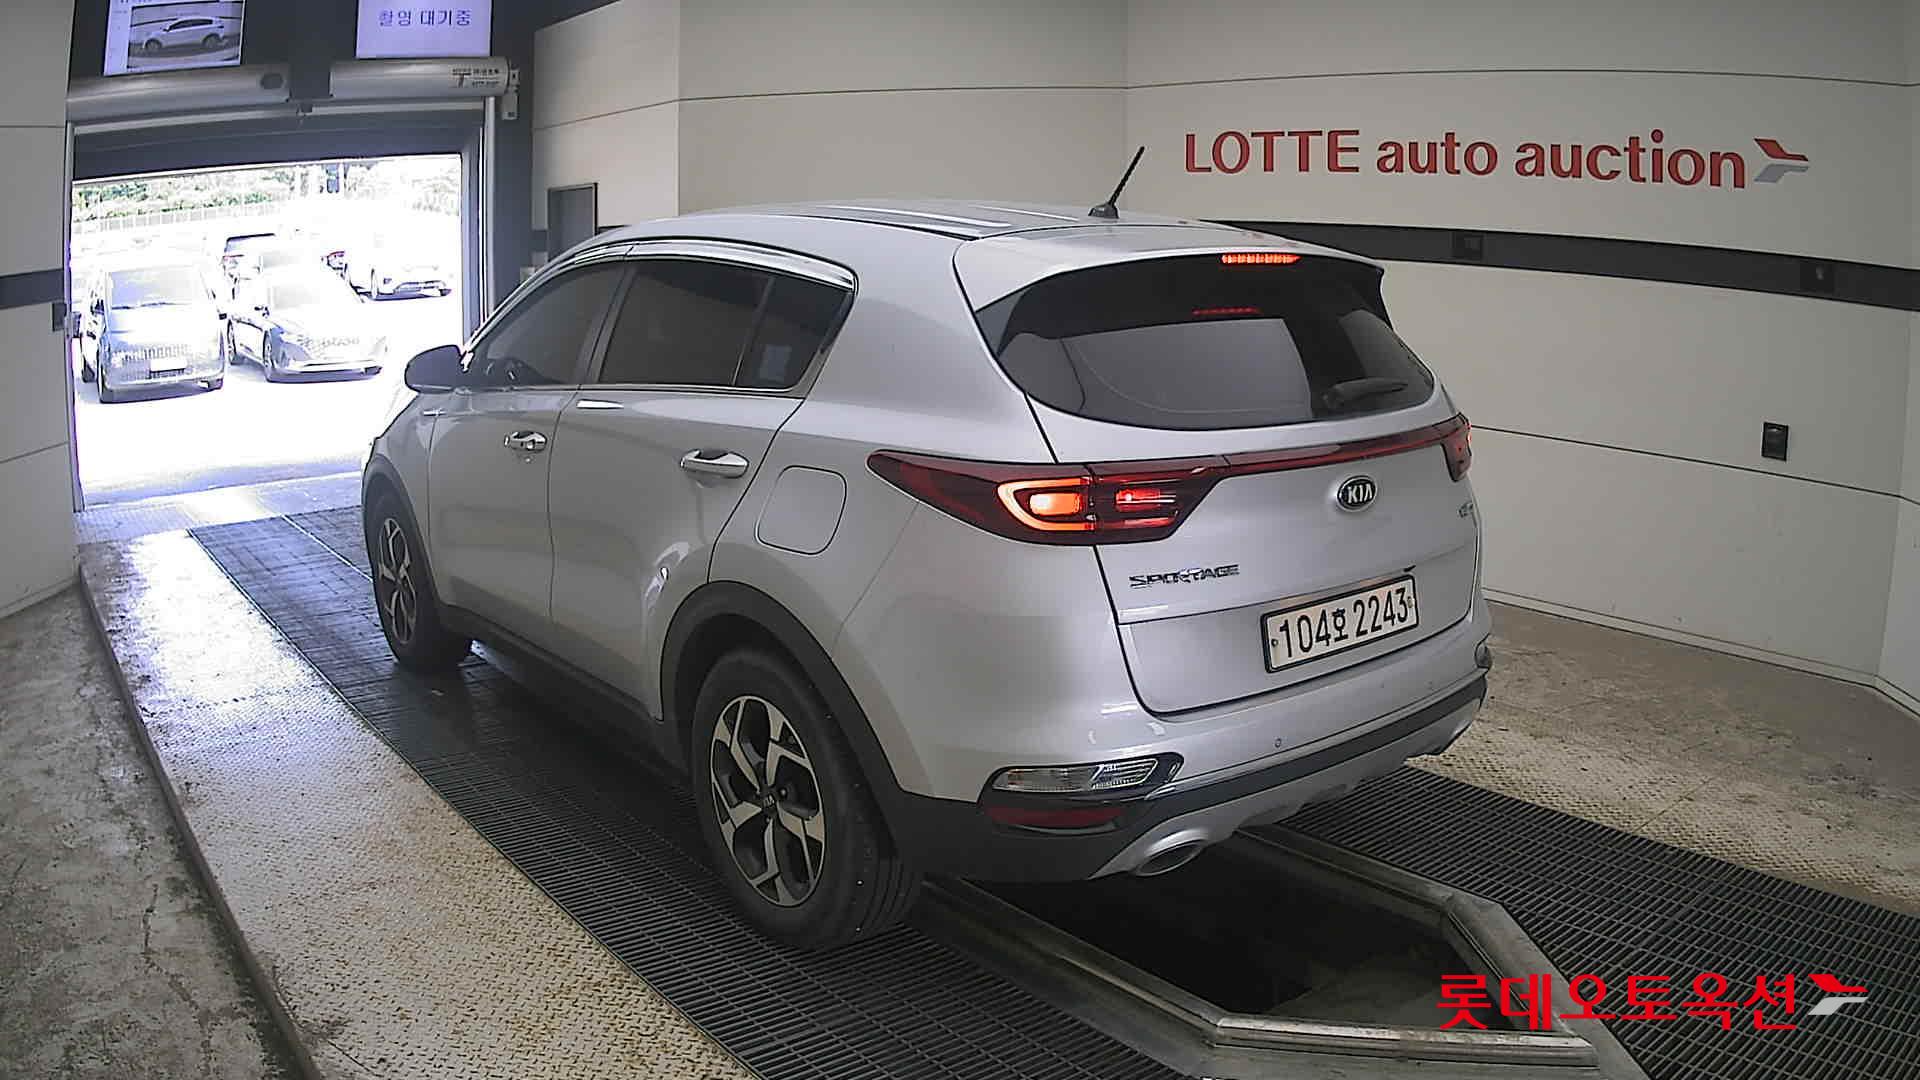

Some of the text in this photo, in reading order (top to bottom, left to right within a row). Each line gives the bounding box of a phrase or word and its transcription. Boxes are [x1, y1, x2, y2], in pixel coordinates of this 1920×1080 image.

[420, 9, 472, 26] 대기중
[1185, 129, 1746, 188] LOTTE auto auction
[1347, 483, 1373, 504] KIA
[1128, 564, 1240, 589] SPORTAGE
[1279, 587, 1408, 658] 104호 2243
